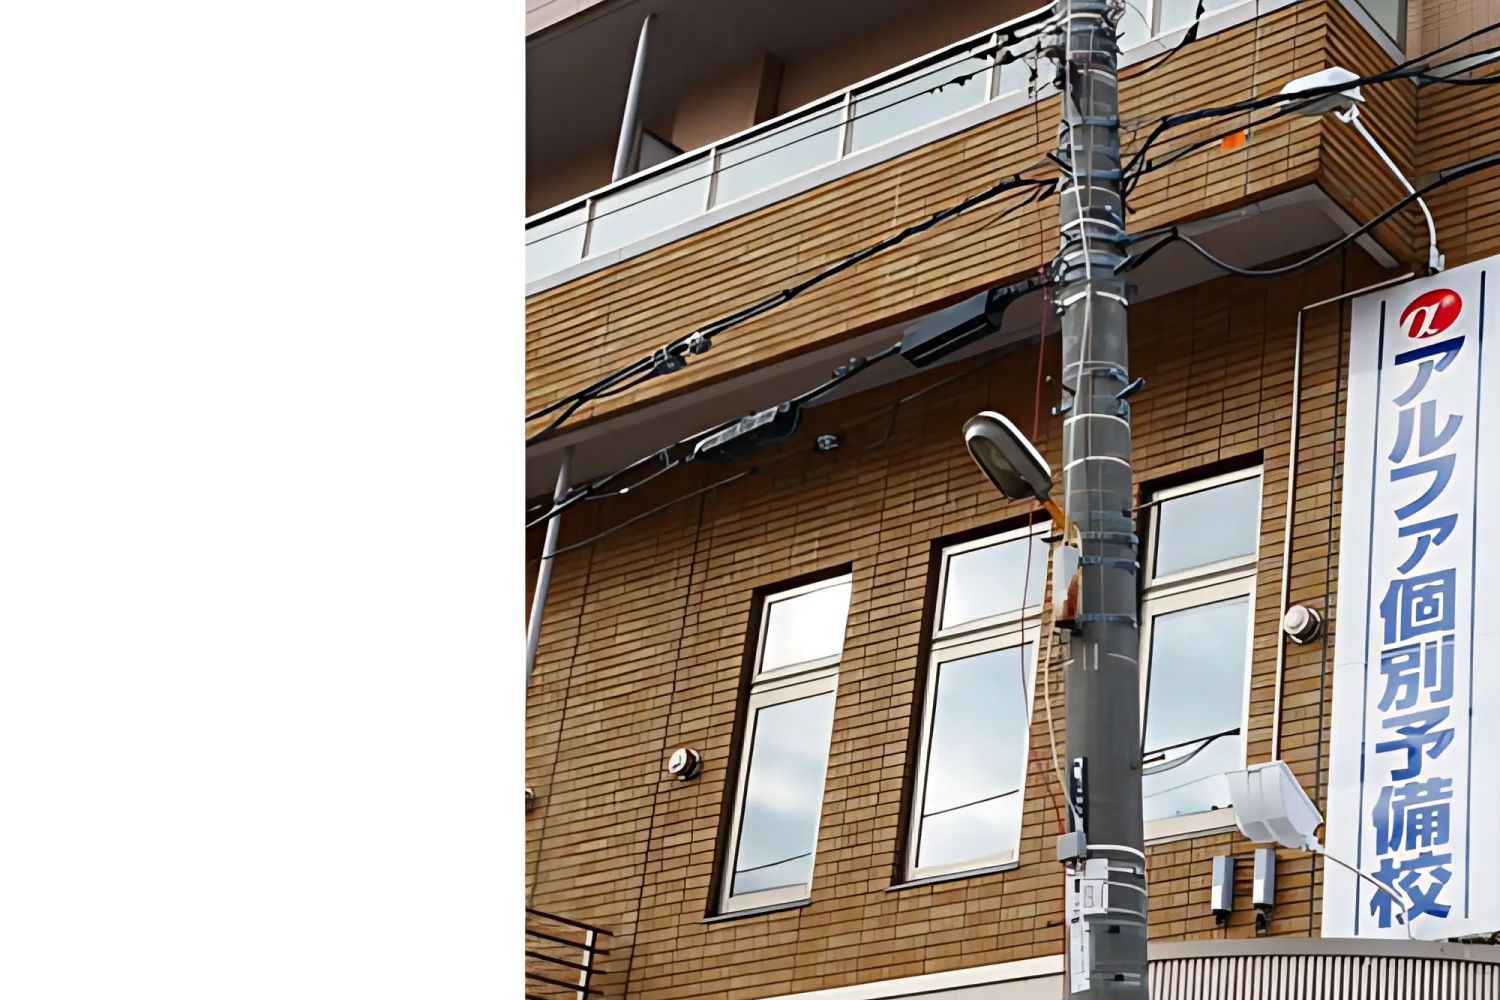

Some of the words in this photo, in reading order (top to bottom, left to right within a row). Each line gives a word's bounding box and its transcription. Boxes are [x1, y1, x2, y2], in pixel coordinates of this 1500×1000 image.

[1370, 335, 1466, 929] アルファ個別予備校
